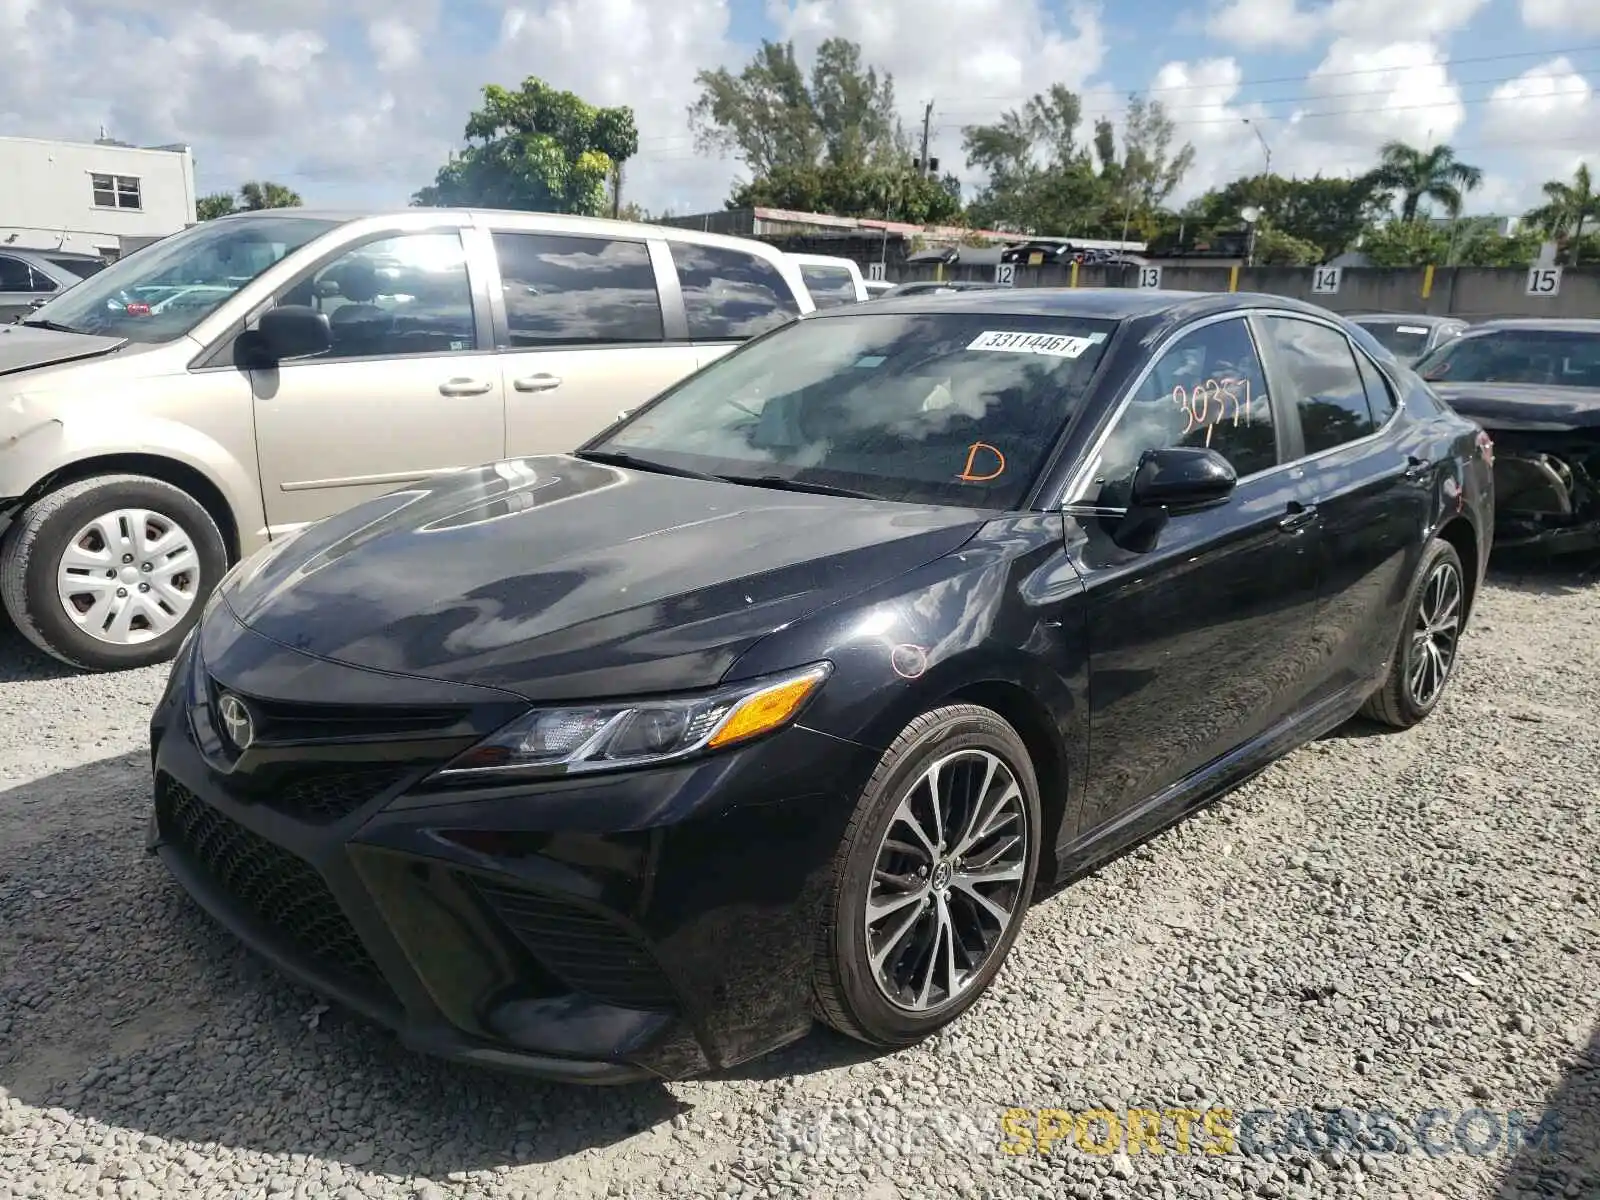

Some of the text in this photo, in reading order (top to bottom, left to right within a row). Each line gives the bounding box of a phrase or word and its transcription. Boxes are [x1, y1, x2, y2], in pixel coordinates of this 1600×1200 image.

[871, 266, 883, 281] 11
[998, 266, 1012, 284] 12
[1143, 267, 1158, 286] 13
[1316, 269, 1337, 290] 14
[1531, 270, 1557, 292] 15
[957, 440, 1006, 482] D
